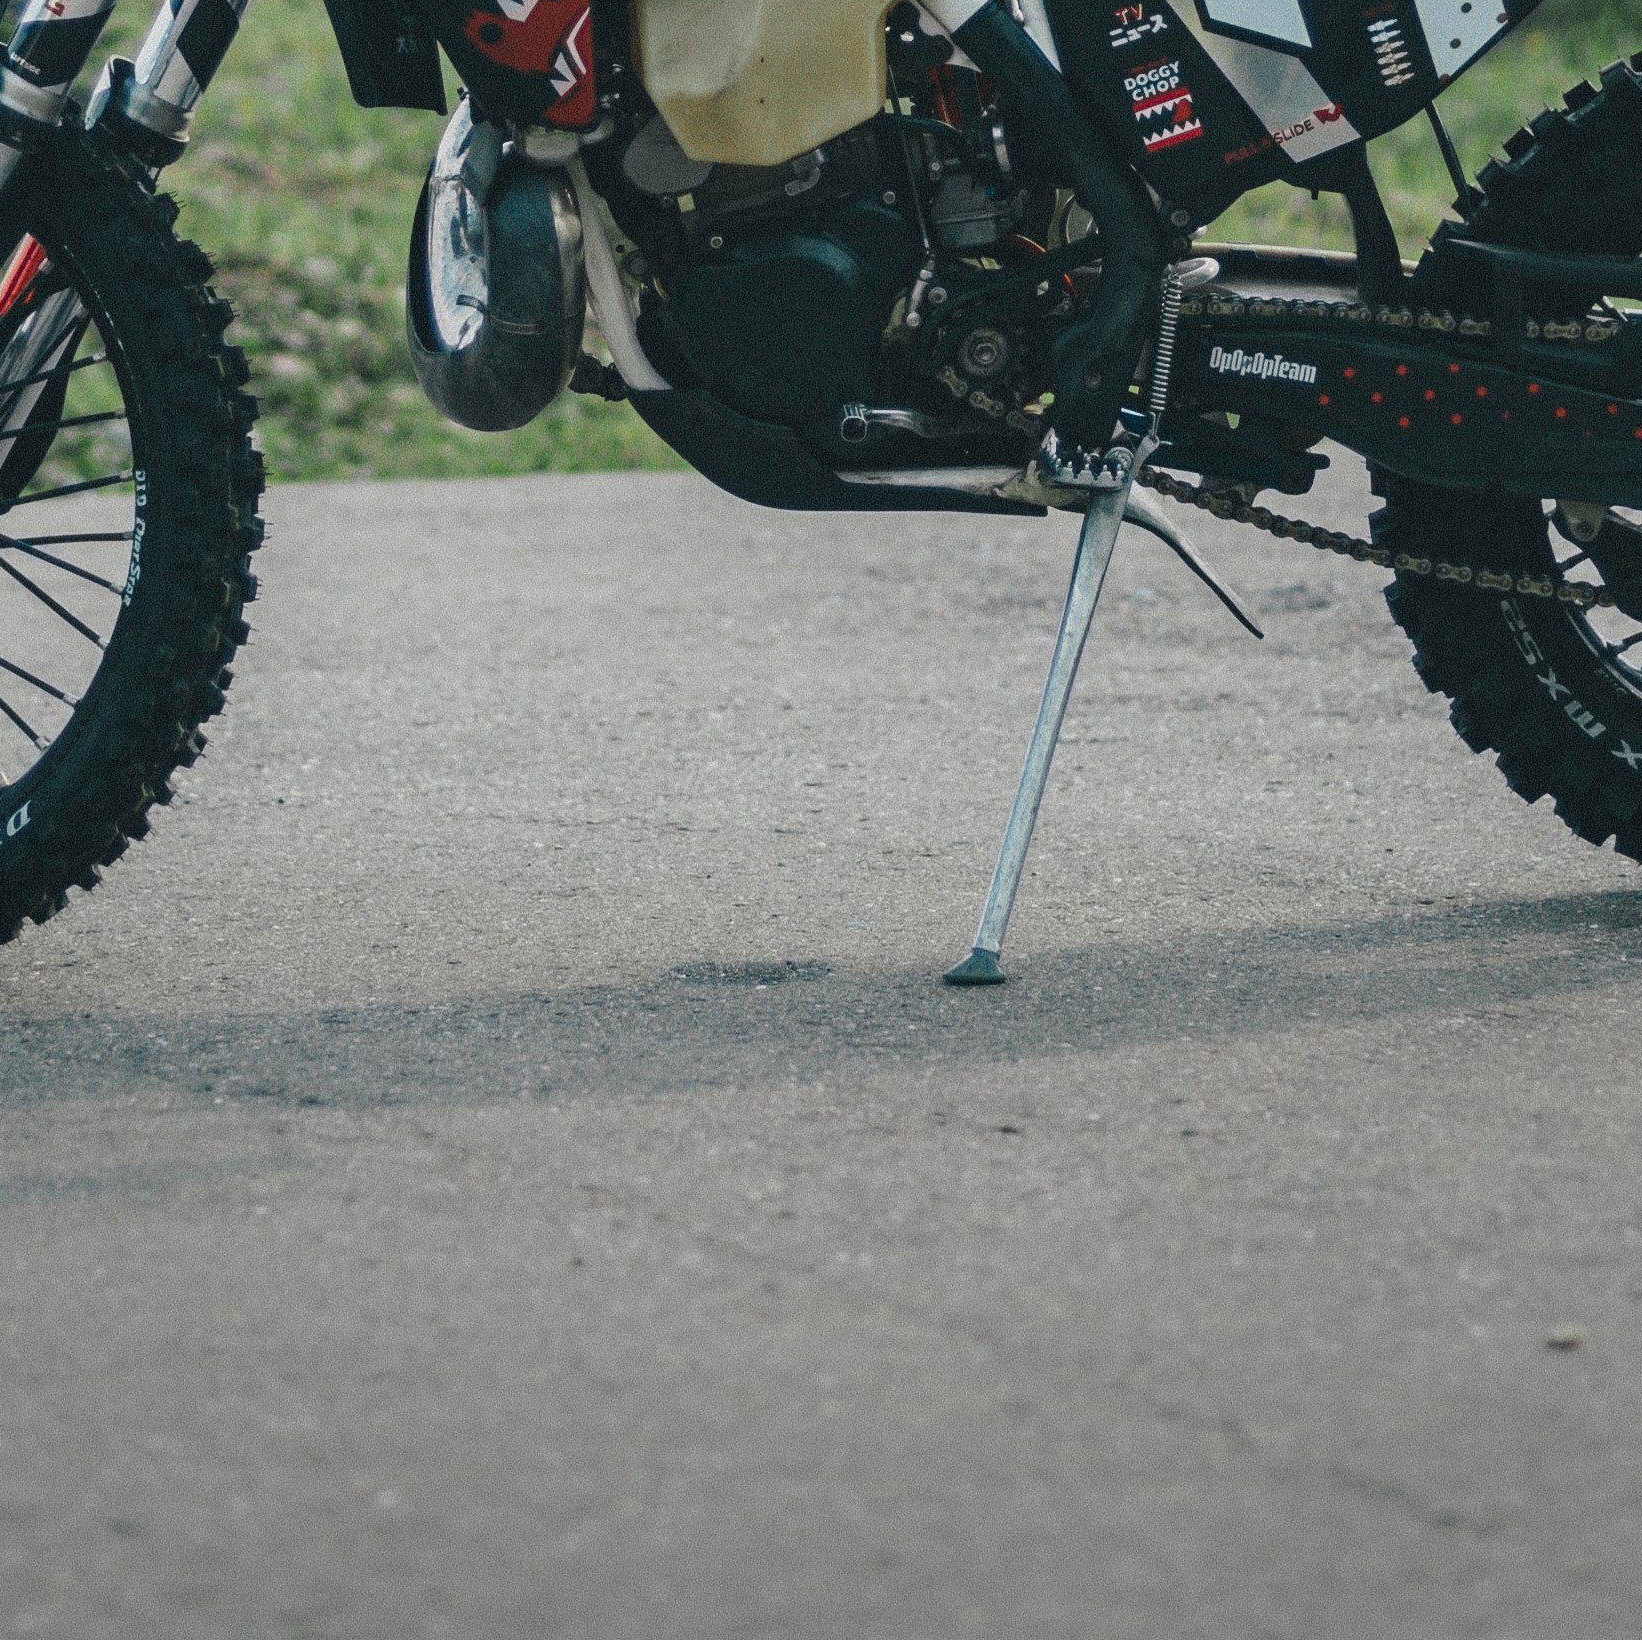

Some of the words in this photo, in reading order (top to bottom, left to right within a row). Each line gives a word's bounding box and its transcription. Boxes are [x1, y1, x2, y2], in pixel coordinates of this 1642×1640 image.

[1115, 3, 1143, 25] TV
[1109, 14, 1168, 48] ニュース
[1123, 60, 1181, 91] DOGGY
[1131, 75, 1181, 102] CHOP
[1272, 118, 1316, 144] SLIDE
[1209, 345, 1318, 385] OpOpOpTeam
